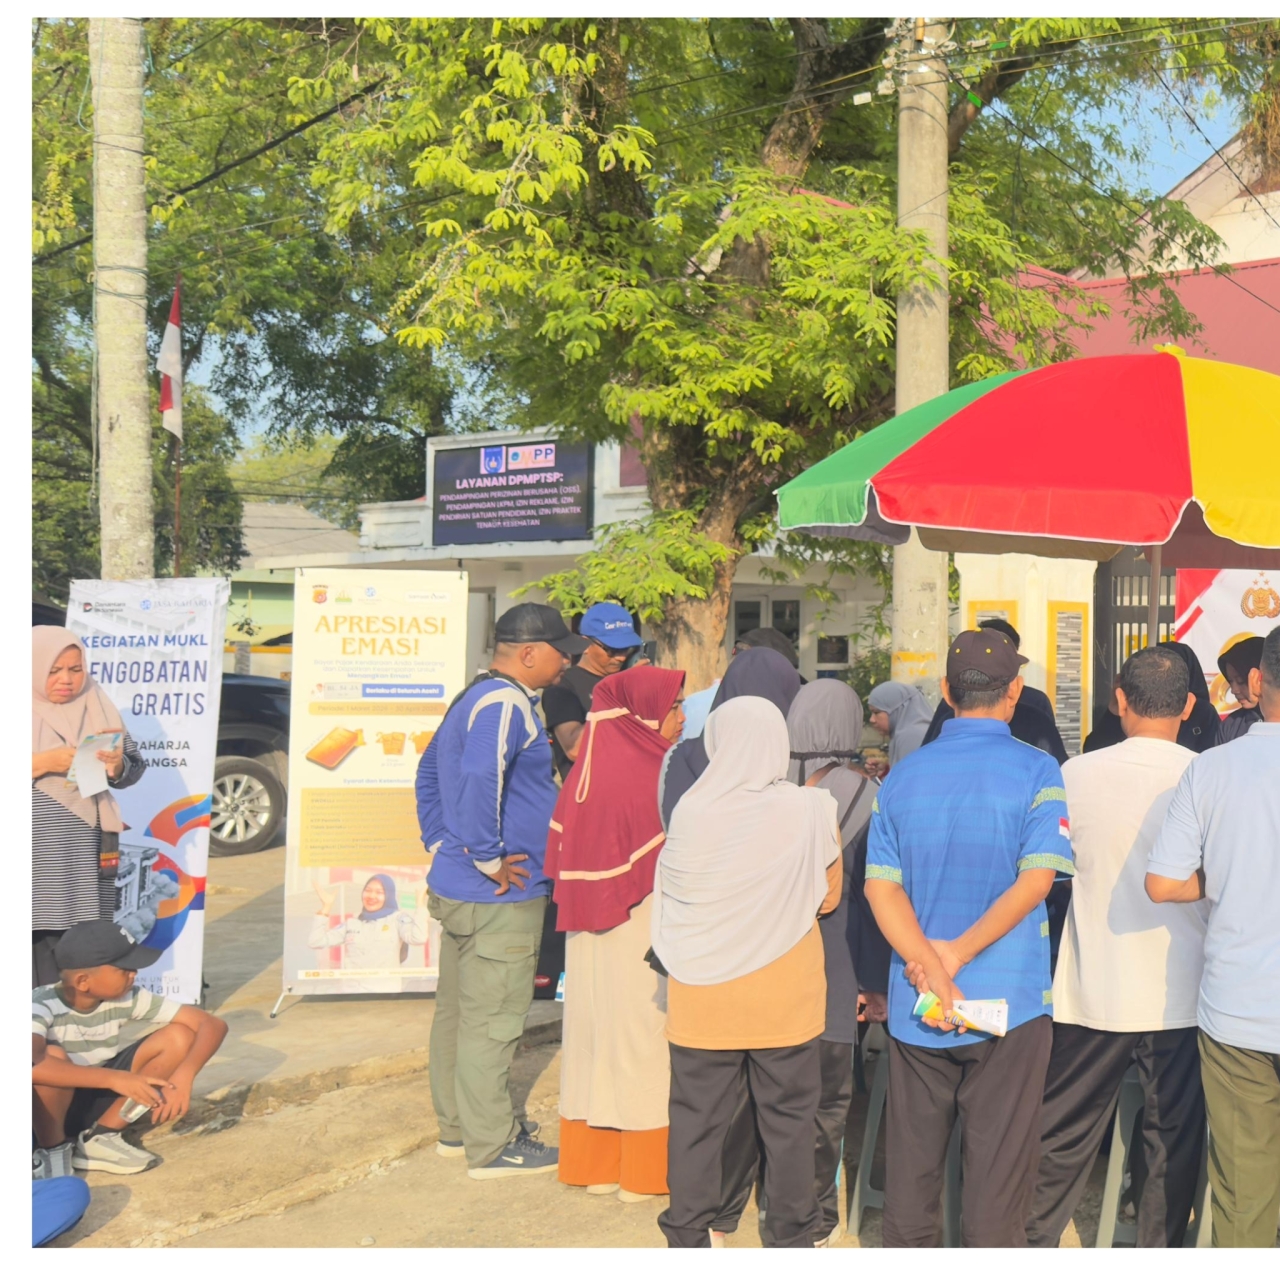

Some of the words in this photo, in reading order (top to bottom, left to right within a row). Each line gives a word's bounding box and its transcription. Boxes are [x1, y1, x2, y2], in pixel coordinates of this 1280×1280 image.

[455, 476, 507, 490] LAYANAN
[508, 472, 564, 486] DPMPTSP:
[439, 491, 488, 502] PENDAMPINGAN
[523, 487, 558, 497] BERUSAHA
[446, 501, 496, 511] PENDAMPINGAN
[471, 511, 497, 520] SATUAN
[552, 506, 582, 515] PRAKTEK
[314, 614, 447, 635] APRESIASI
[81, 635, 159, 649] KEGIATAN
[163, 634, 208, 647] MUKL
[341, 637, 420, 656] EMAS!
[90, 660, 208, 684] ENGOBATAN
[131, 692, 205, 717] GRATIS
[144, 757, 188, 768] ANGSA
